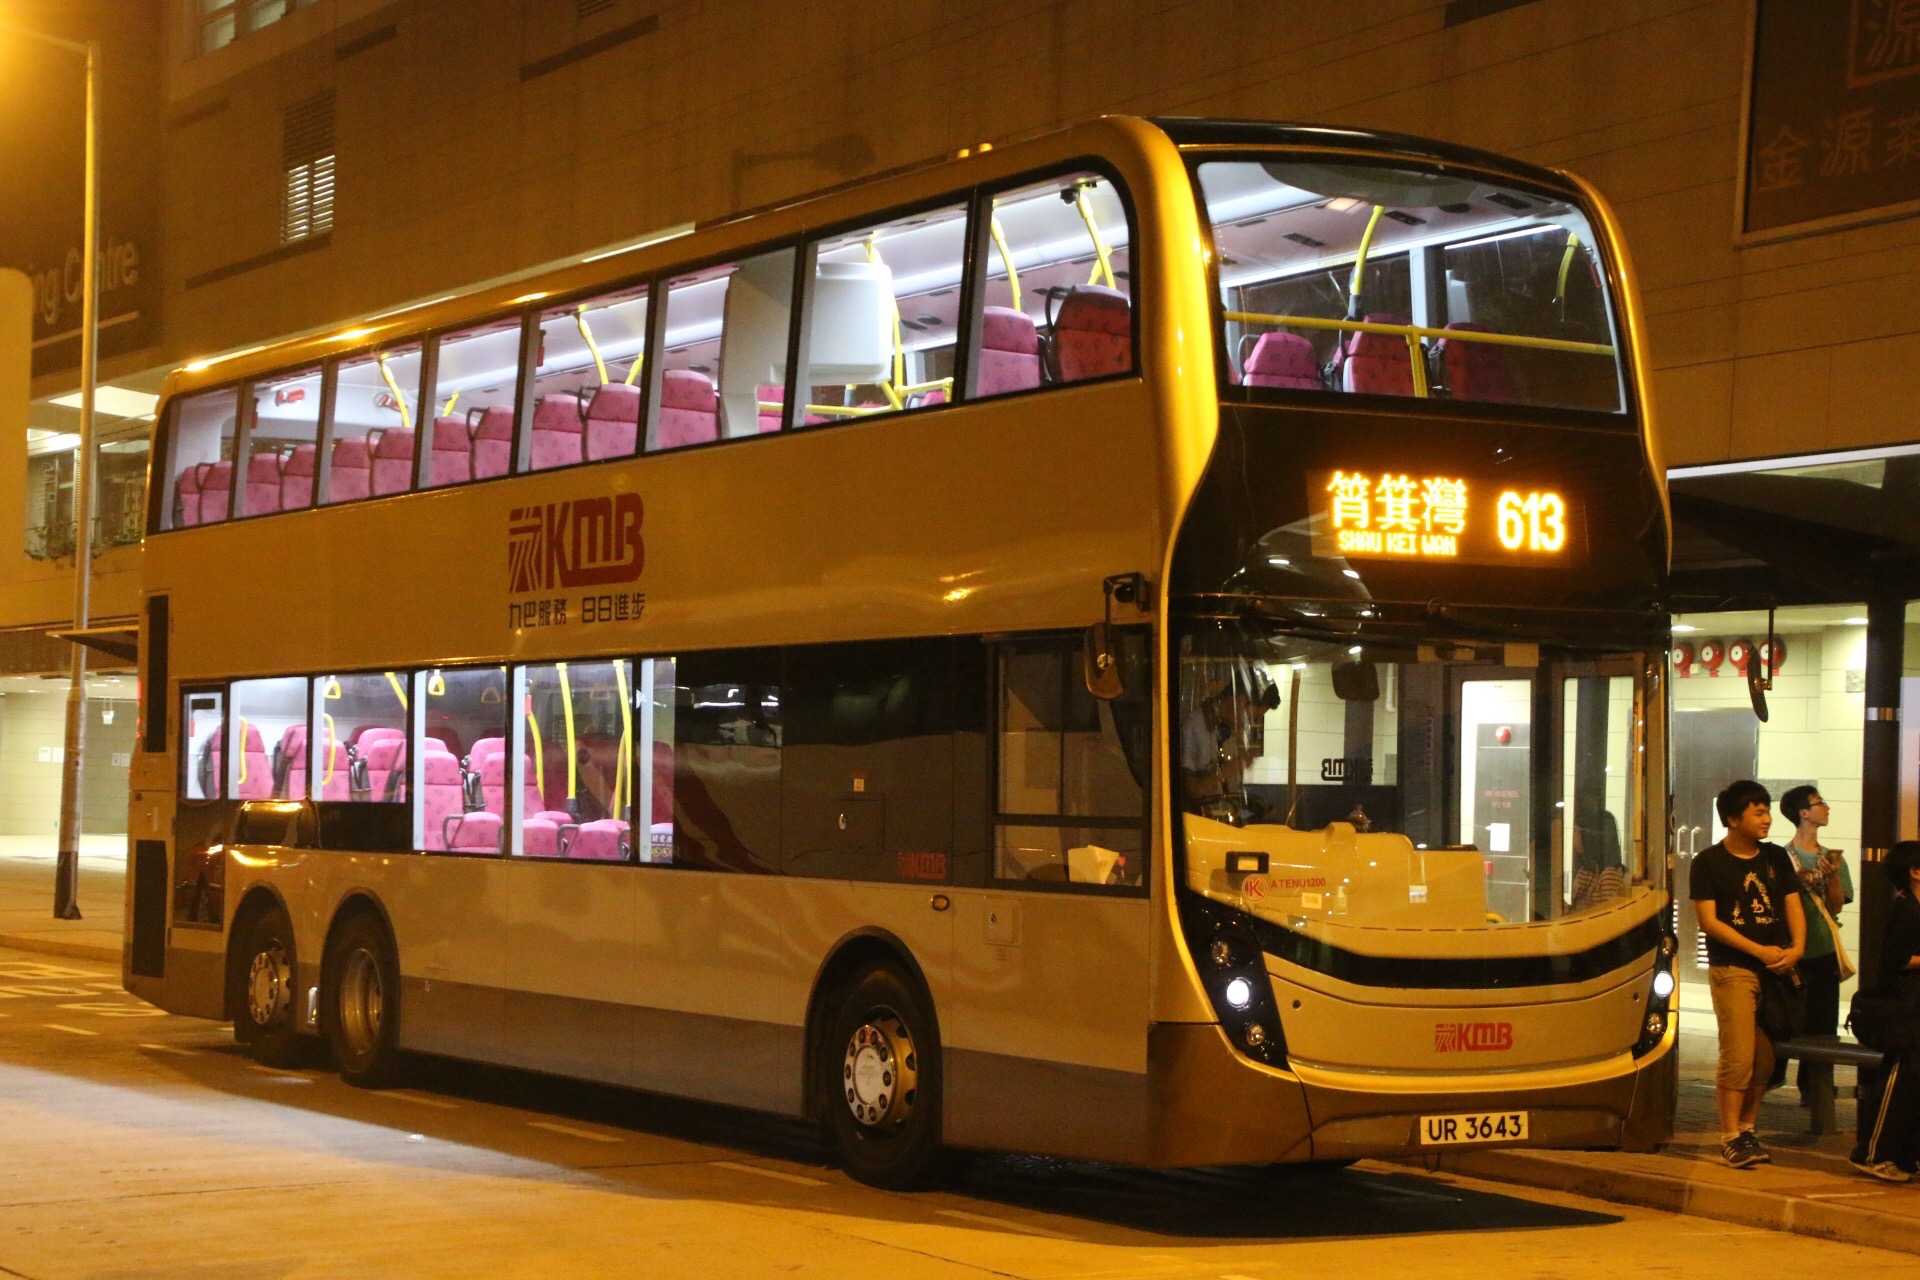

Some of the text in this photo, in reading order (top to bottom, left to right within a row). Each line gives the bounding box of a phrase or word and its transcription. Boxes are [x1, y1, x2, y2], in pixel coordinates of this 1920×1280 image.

[1327, 470, 1469, 533] 筲箕灣
[1496, 490, 1567, 552] 613
[547, 492, 645, 588] KMB
[1338, 529, 1457, 556] SHAU KEI WAN
[582, 593, 645, 623] 日日進步
[1456, 1022, 1513, 1052] KMB
[1428, 1114, 1521, 1141] UR 3643
